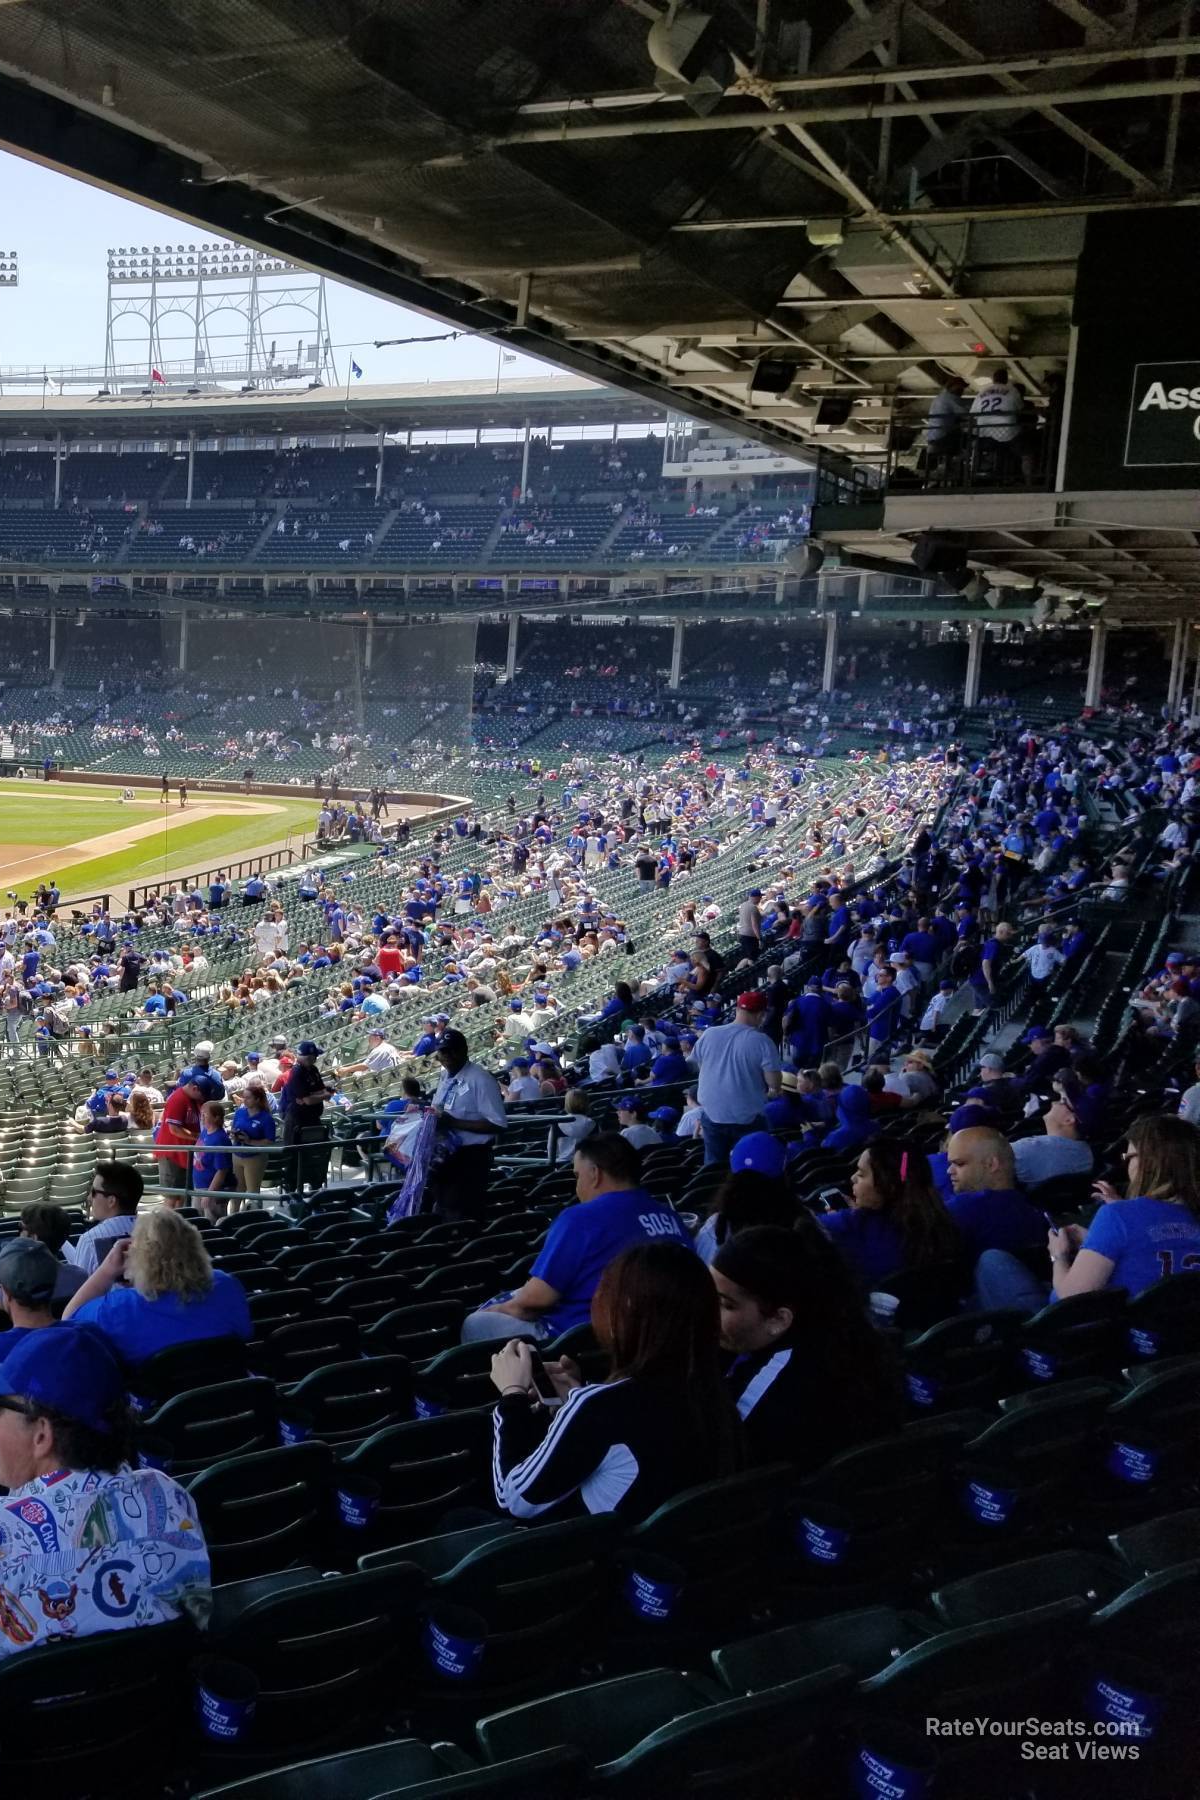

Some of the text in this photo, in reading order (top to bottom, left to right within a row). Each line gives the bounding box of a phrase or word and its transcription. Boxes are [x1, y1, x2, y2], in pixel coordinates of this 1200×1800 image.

[638, 1213, 681, 1237] SOSA
[210, 1721, 239, 1736] Hefty
[866, 1772, 905, 1798] Hefty
